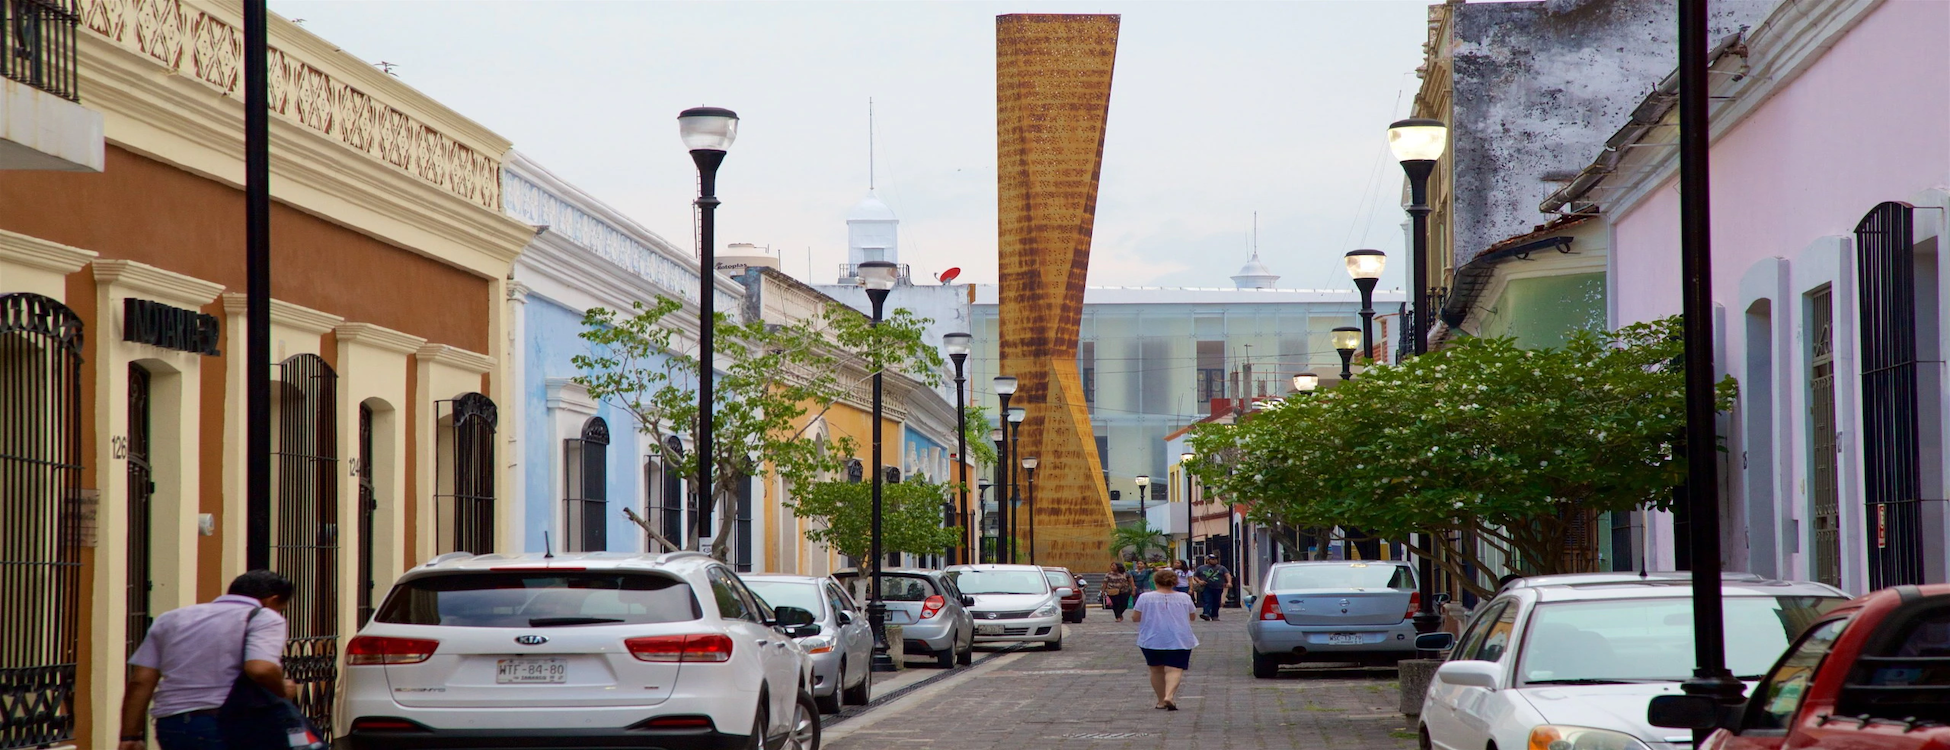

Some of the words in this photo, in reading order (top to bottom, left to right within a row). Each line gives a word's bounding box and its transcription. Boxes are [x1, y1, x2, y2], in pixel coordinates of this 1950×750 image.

[123, 297, 200, 352] NOTARIA
[111, 435, 127, 459] 126
[518, 635, 544, 645] KIA
[499, 664, 564, 675] WTF-84-80
